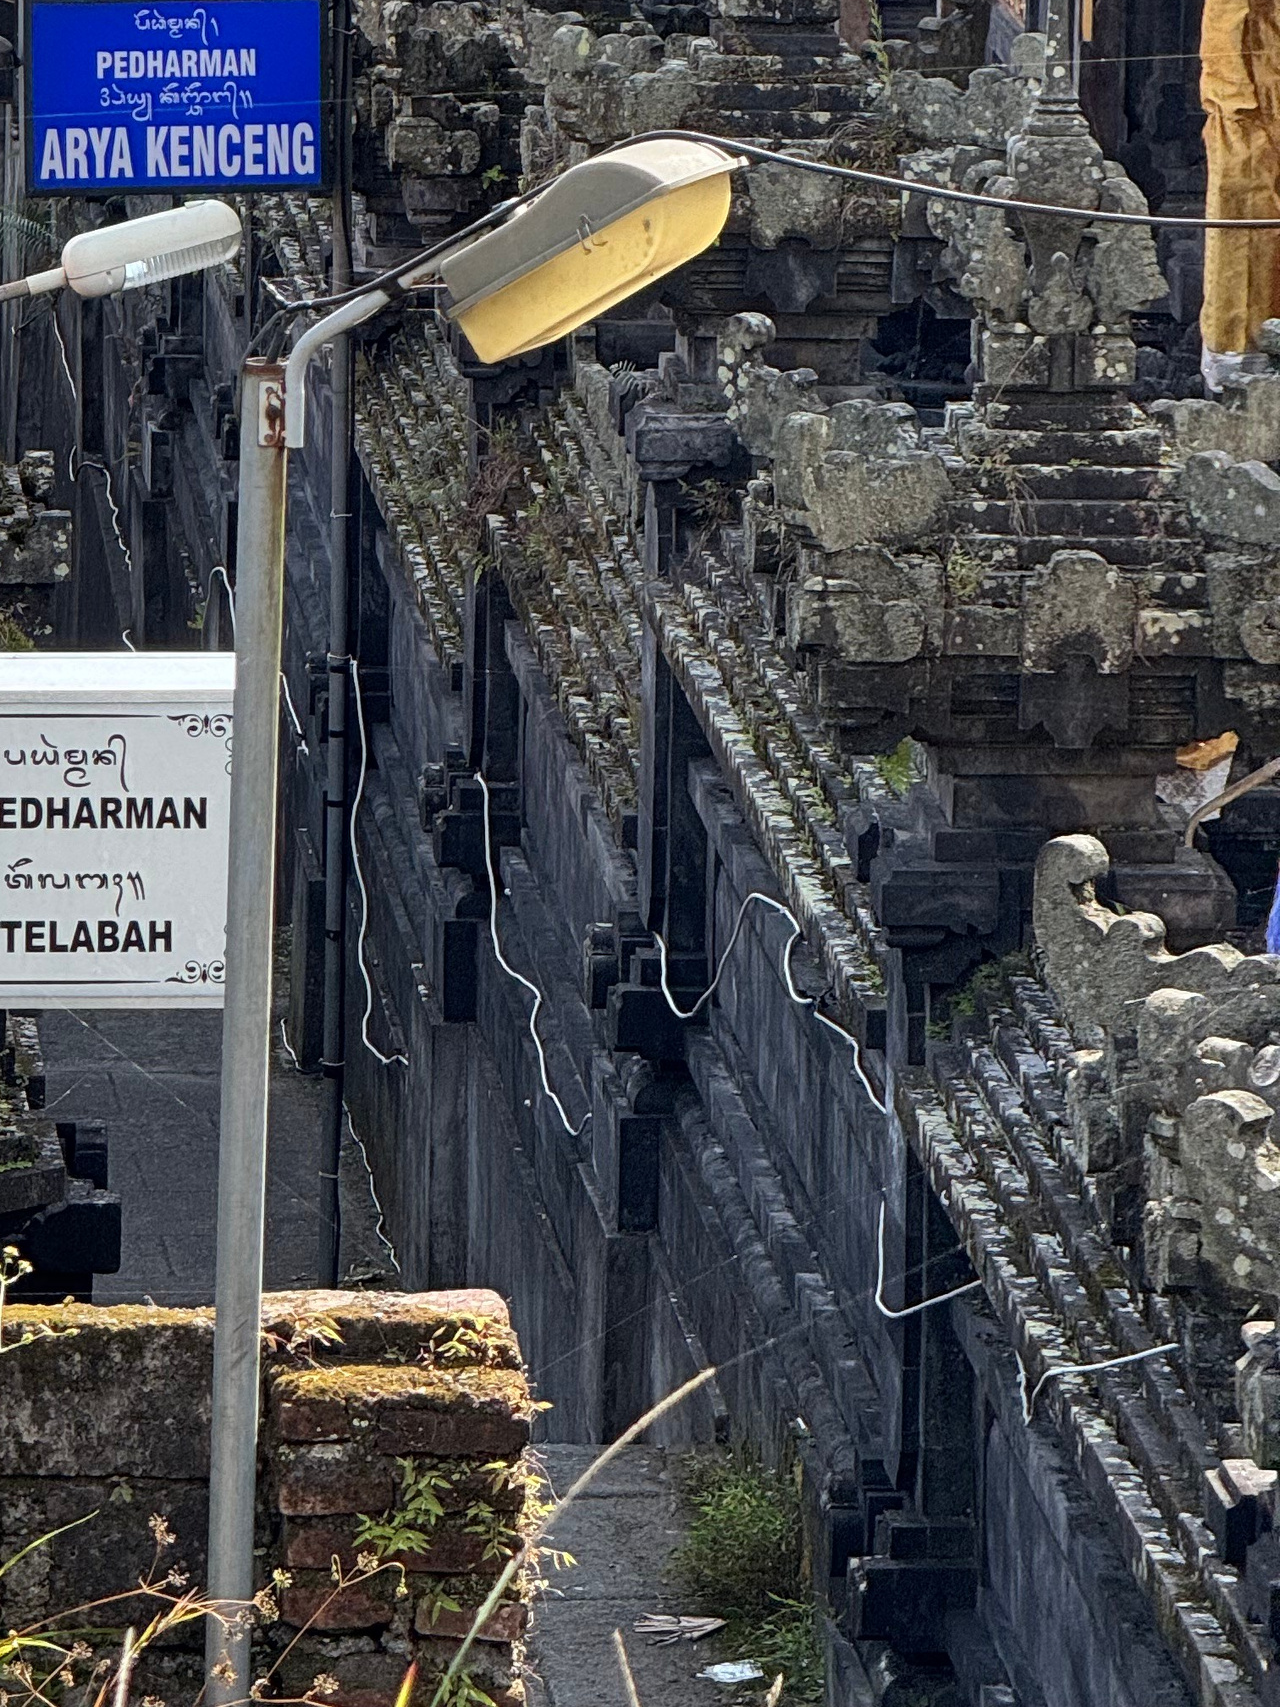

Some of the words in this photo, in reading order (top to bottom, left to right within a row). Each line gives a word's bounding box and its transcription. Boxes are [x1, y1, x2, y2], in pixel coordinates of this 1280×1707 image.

[96, 48, 257, 79] PEDHARMAN
[40, 126, 134, 180] ARYA
[146, 122, 315, 178] KENCENG
[0, 920, 173, 953] TELABAH
